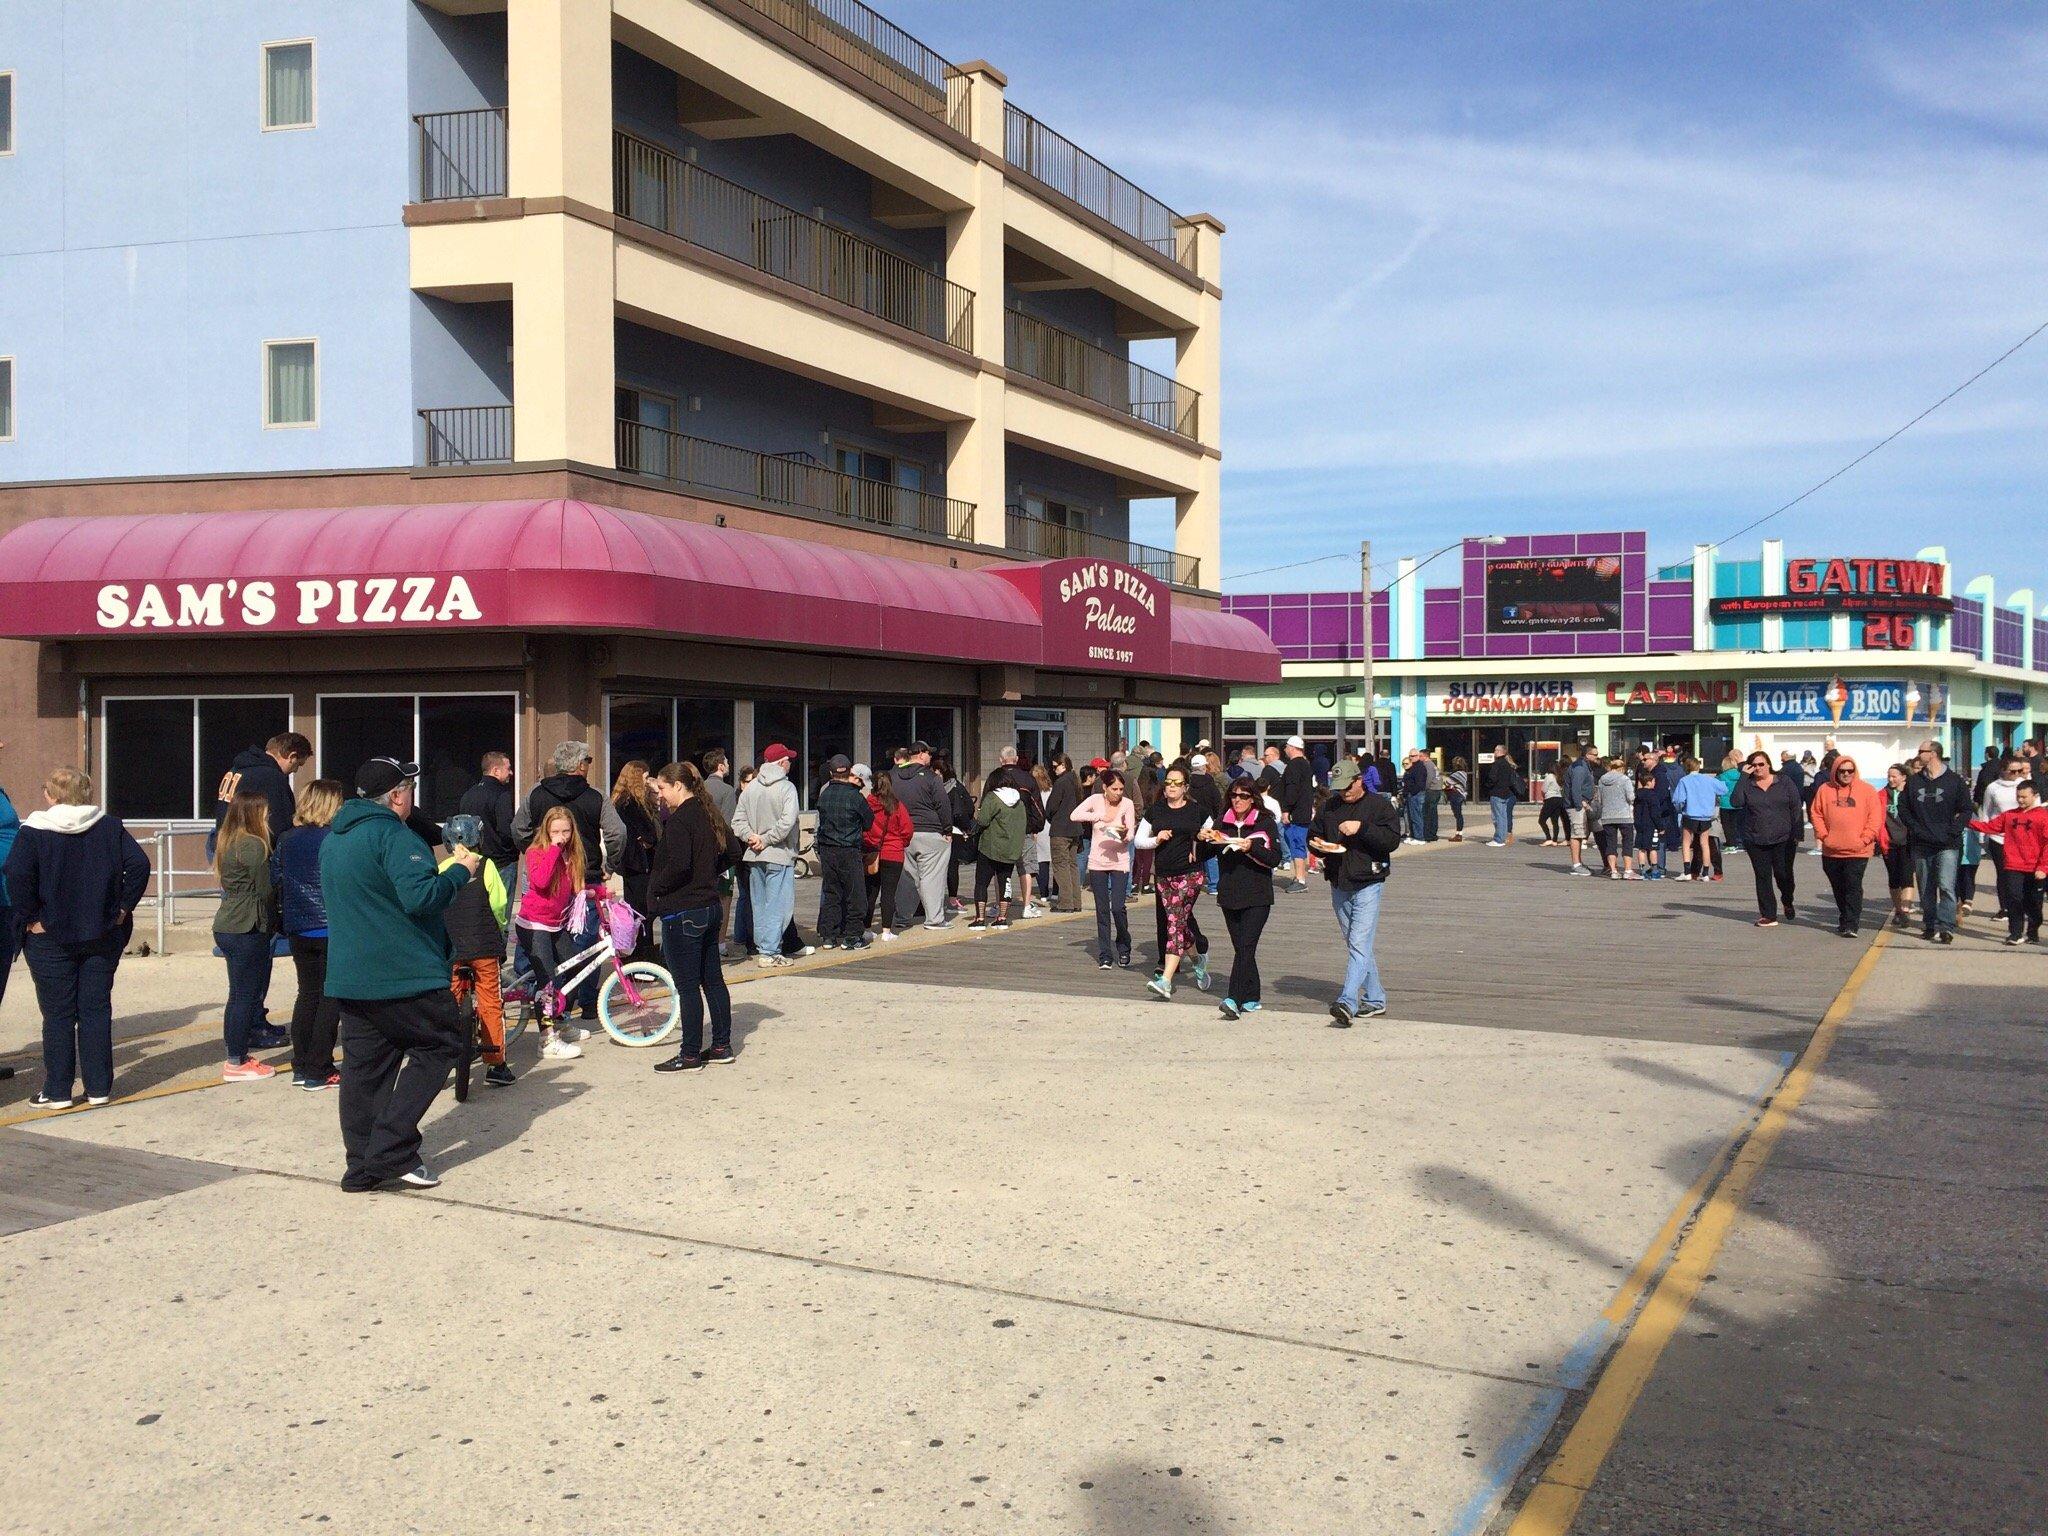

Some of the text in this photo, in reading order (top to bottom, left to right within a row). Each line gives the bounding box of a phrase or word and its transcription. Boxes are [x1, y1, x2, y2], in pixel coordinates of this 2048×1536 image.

[96, 575, 483, 628] SAM'S PIZZA
[1060, 562, 1155, 617] SAM'S PIZZA
[1084, 596, 1137, 635] Palace
[1720, 599, 1825, 610] with European record
[1501, 616, 1605, 626] www.gateway26.com
[1863, 613, 1915, 650] 26
[1088, 646, 1134, 663] SINCE 1957
[1449, 680, 1574, 698] SLOT/POKER
[1606, 679, 1738, 707] CASINO
[1755, 688, 1900, 715] KOHR BROS
[1443, 695, 1579, 715] TOURNAMENTS
